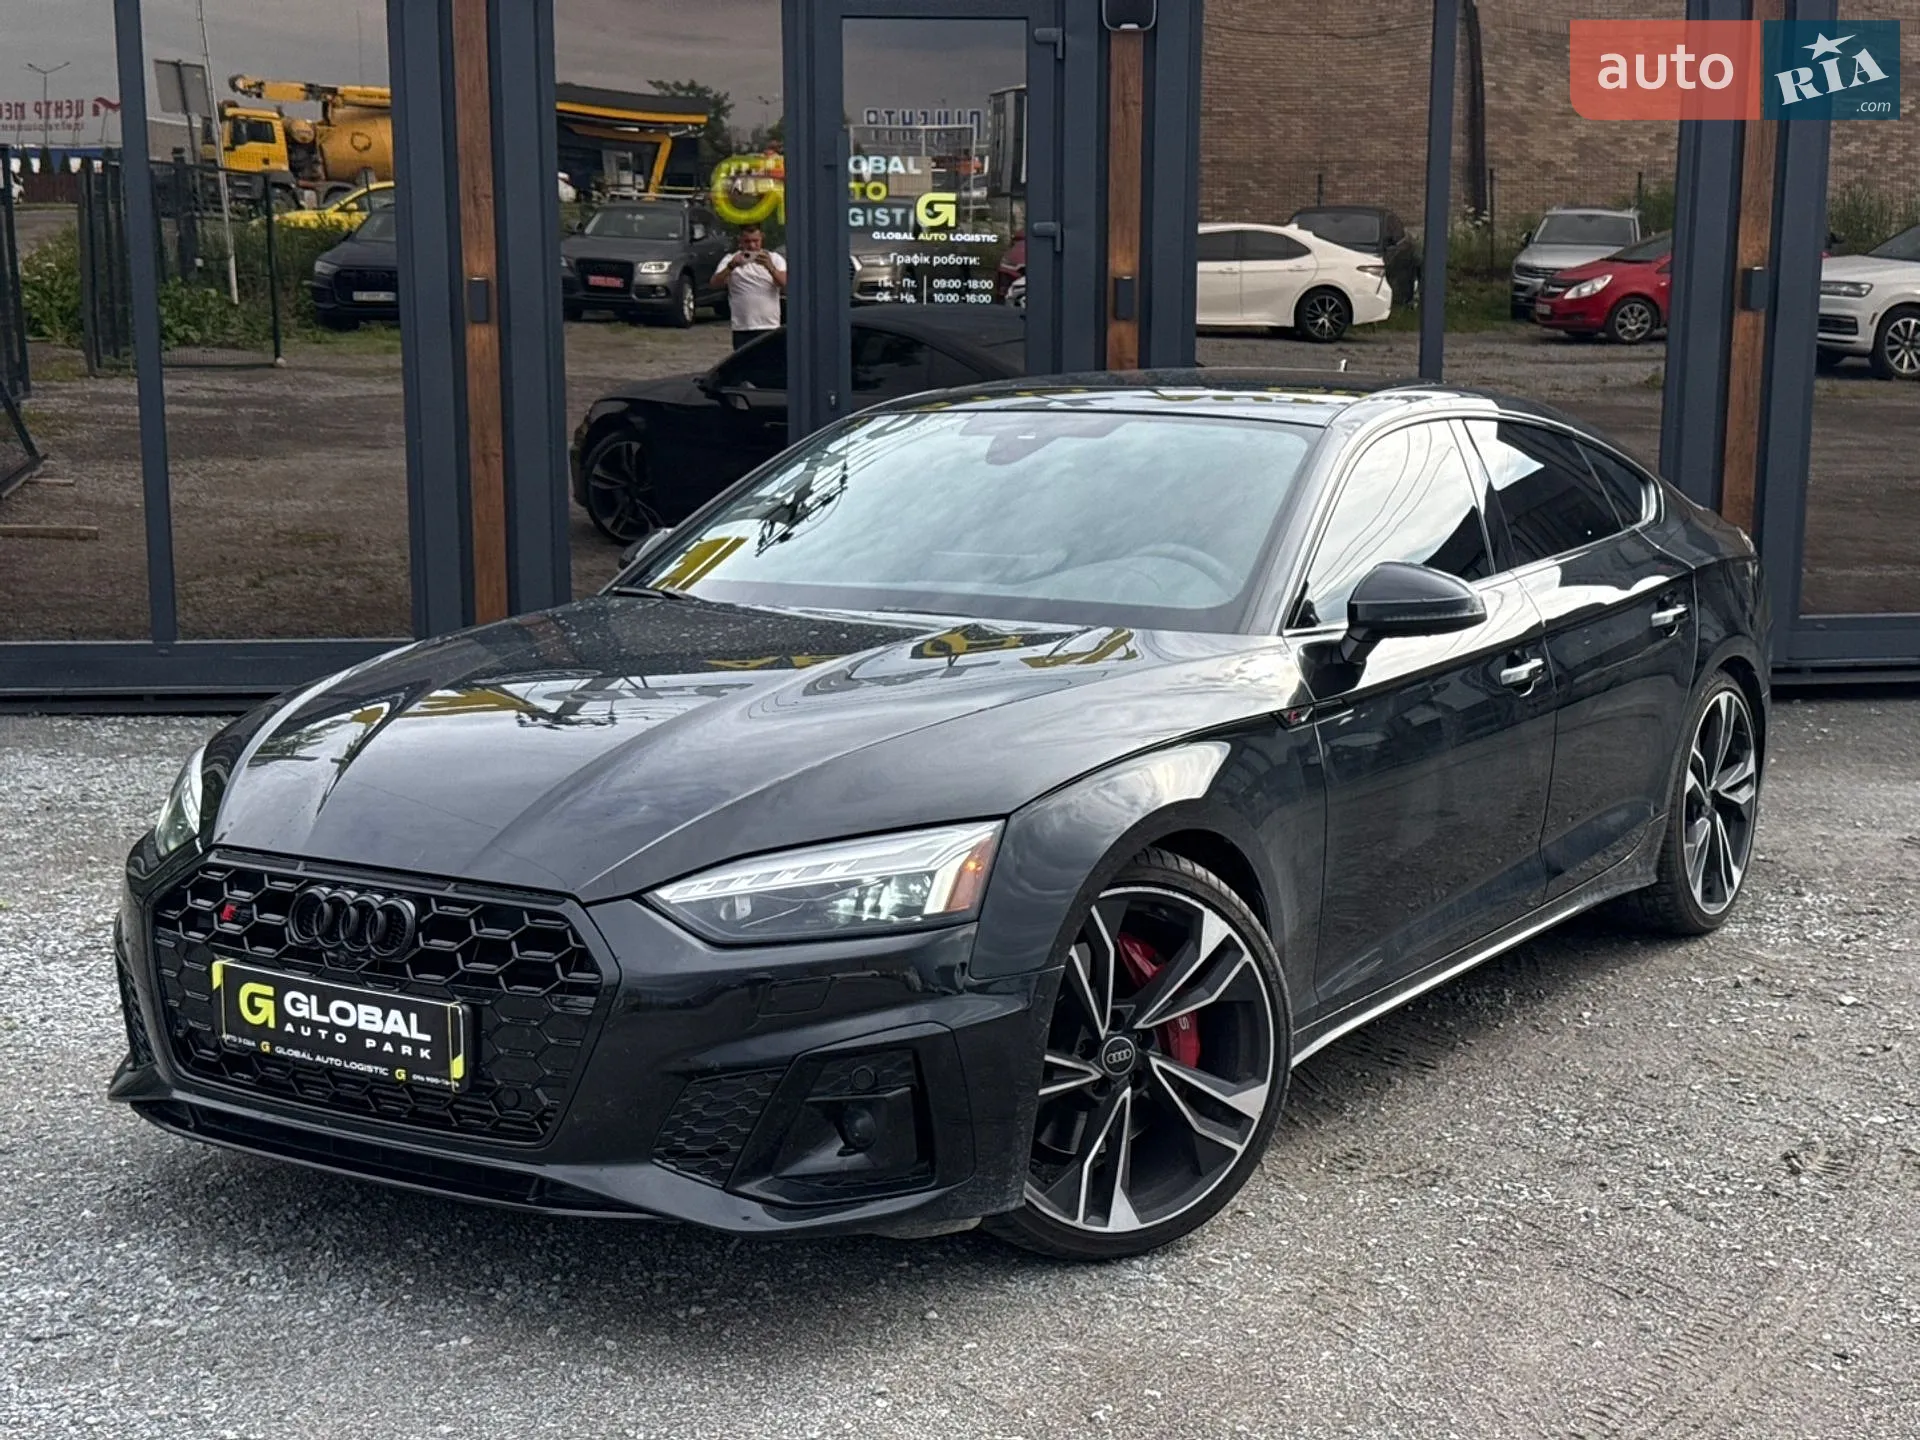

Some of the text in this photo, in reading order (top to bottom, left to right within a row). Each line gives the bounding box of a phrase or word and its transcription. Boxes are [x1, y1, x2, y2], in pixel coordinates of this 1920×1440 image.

[848, 155, 923, 174] OBAL
[848, 181, 887, 200] TO
[848, 207, 916, 227] GISTI
[872, 231, 998, 243] GLOBAL AUTO LOGISTIC
[889, 252, 980, 267] Графік роботи:
[933, 278, 961, 289] 09:00
[933, 293, 960, 302] 10:00
[283, 990, 432, 1042] GLOBAL
[284, 1022, 432, 1060] AUTO PARK
[274, 1045, 390, 1076] GLOBAL AUTO LOGISTIC
